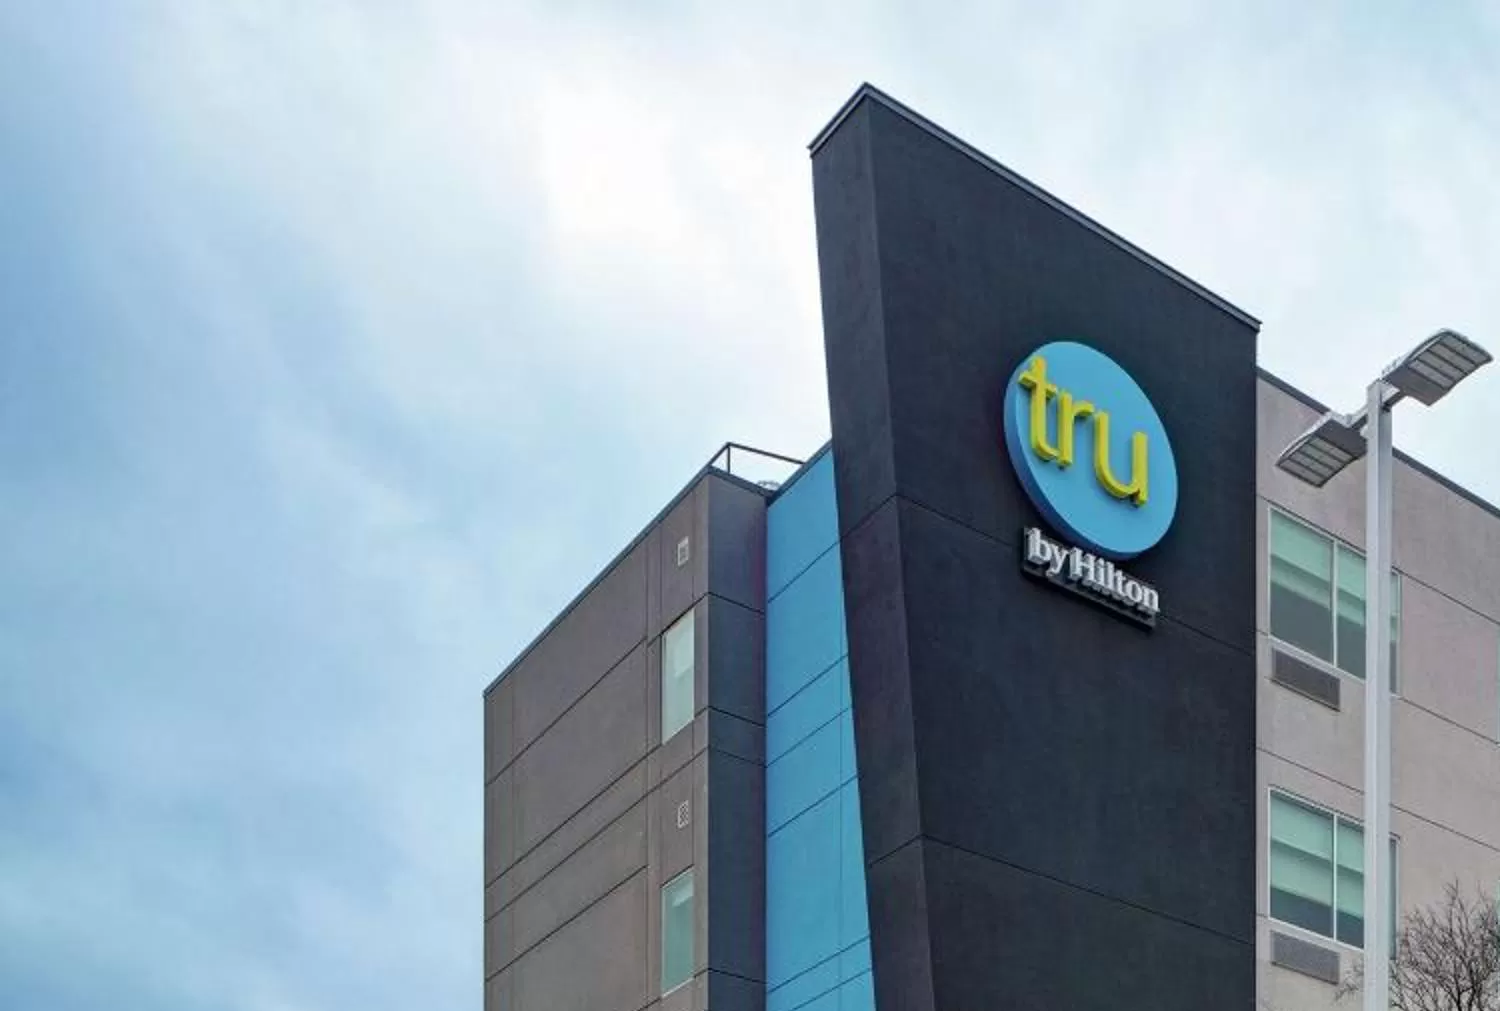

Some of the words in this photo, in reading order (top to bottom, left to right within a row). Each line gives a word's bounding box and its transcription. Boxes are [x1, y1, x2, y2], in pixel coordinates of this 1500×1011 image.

[1018, 356, 1147, 506] tru
[1027, 527, 1069, 577] by
[1069, 547, 1160, 614] Hilton
